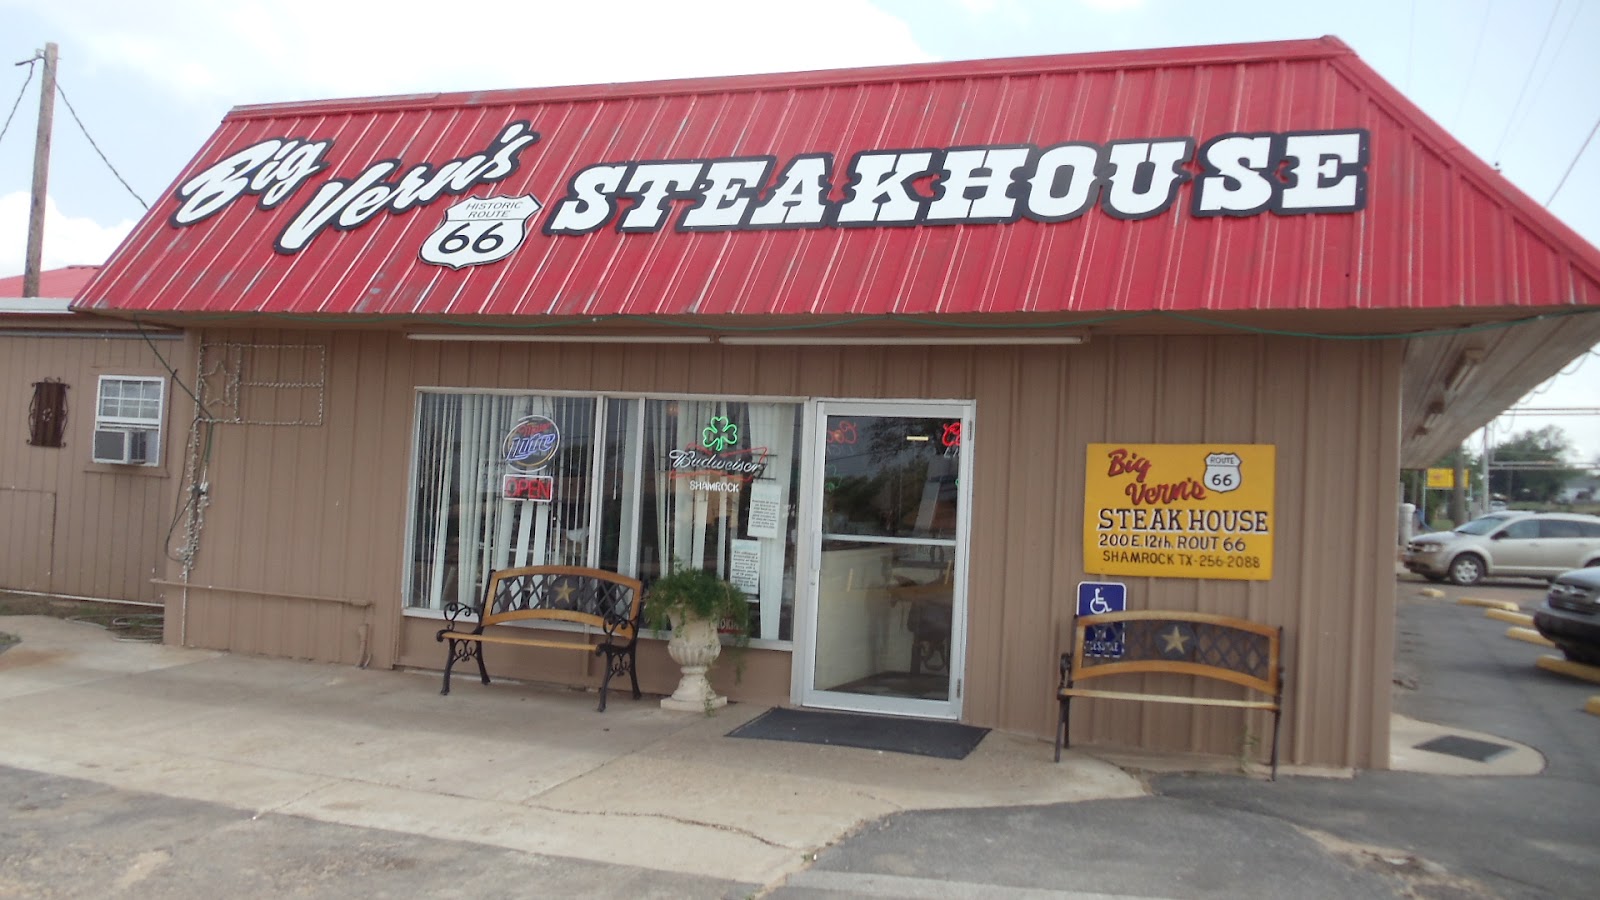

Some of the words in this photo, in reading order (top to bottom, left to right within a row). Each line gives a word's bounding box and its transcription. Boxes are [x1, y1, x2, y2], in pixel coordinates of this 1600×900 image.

[173, 138, 331, 226] Big
[278, 122, 536, 251] Vern's
[547, 131, 1364, 232] STEAKHOUSE
[465, 200, 523, 211] HISTORIC
[467, 210, 511, 218] ROUTE
[438, 221, 504, 254] 66
[505, 433, 556, 461] Lite
[669, 449, 764, 474] Budweiser
[1107, 448, 1152, 483] Big
[1210, 456, 1235, 465] ROUTE
[506, 476, 551, 499] OPEN
[689, 480, 739, 493] SHAMROCK
[1124, 477, 1207, 506] Vern's
[1211, 473, 1233, 487] 66
[1098, 508, 1182, 531] STEAK
[1188, 509, 1268, 533] HOUSE
[1099, 533, 1128, 547] 200
[1177, 536, 1219, 550] ROUT
[1223, 537, 1246, 552] 66
[1102, 550, 1174, 565] SHAMROCK
